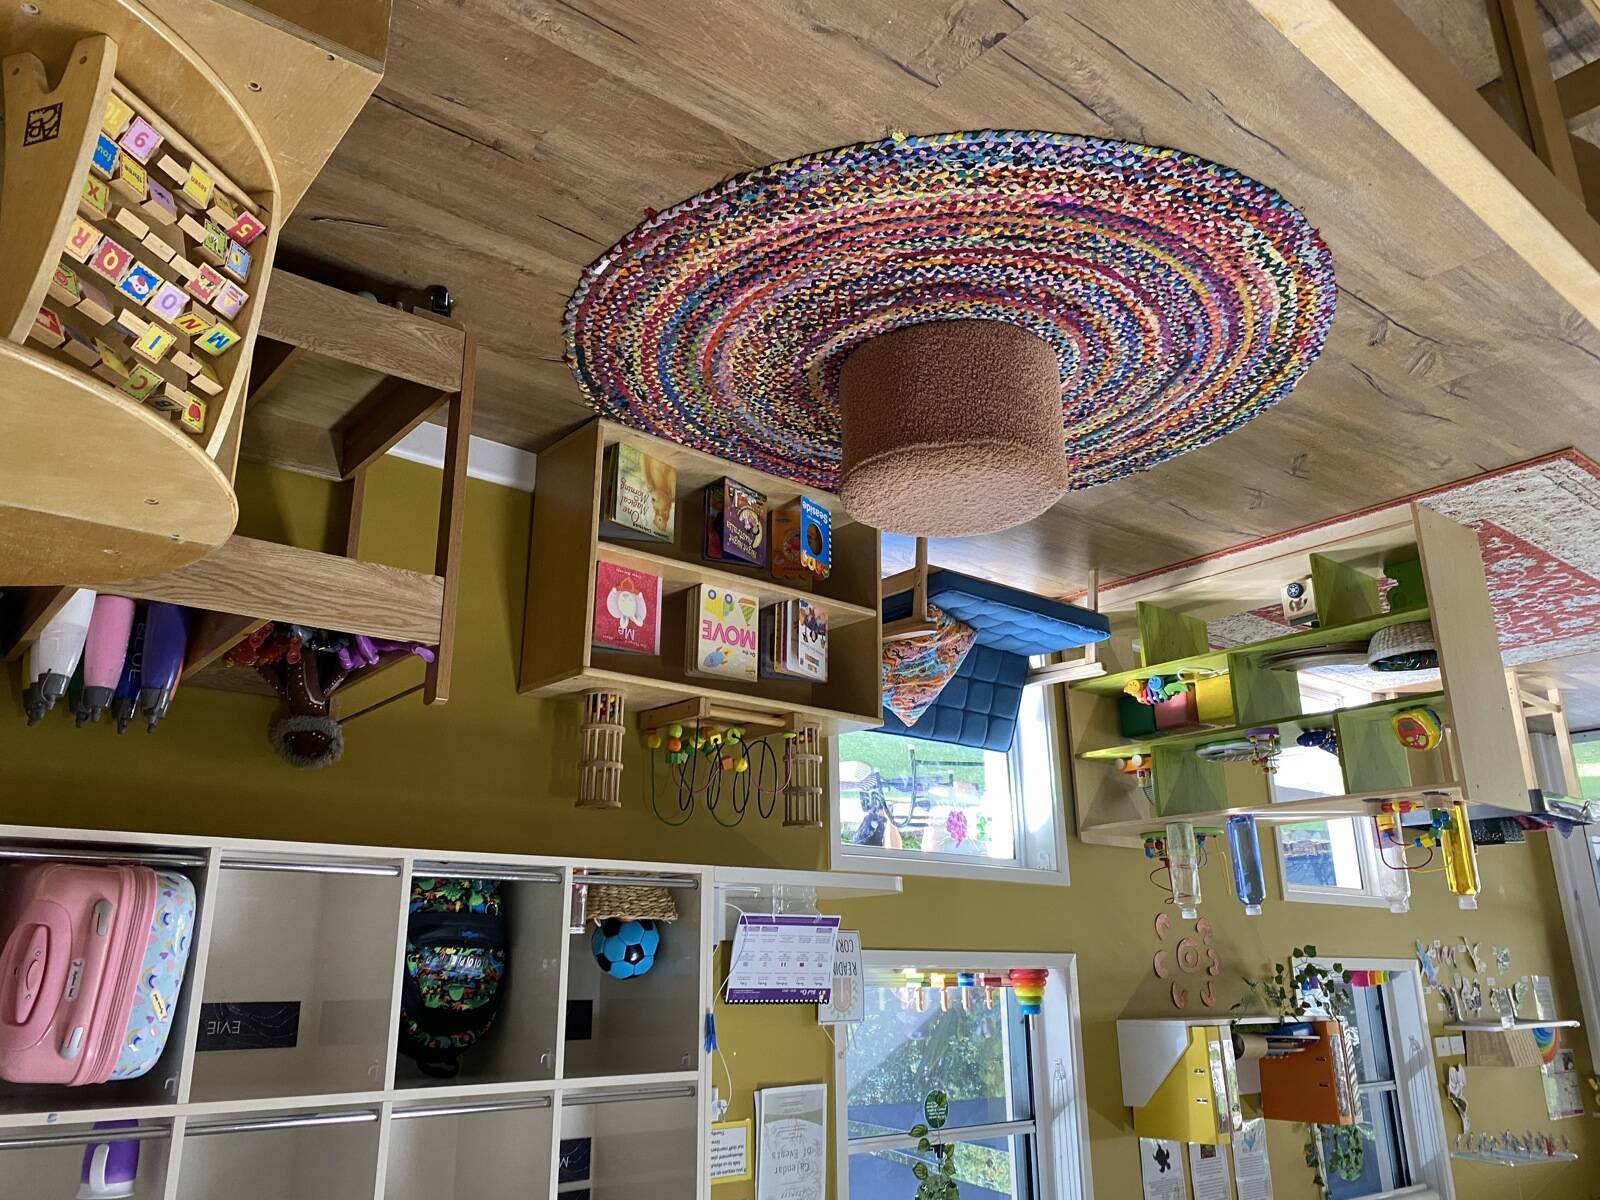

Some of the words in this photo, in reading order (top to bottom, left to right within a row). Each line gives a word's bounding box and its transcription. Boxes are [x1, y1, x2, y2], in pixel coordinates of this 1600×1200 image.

[135, 132, 149, 148] 9
[97, 145, 113, 162] fou
[124, 163, 143, 184] three
[87, 180, 98, 201] X
[190, 175, 208, 193] seven
[71, 228, 91, 249] R
[236, 223, 253, 238] 5
[102, 248, 119, 270] Q
[180, 319, 201, 330] N
[206, 332, 230, 350] M
[129, 374, 147, 391] C
[620, 477, 649, 503] Morning
[620, 495, 649, 516] Magical
[802, 501, 828, 524] Seaside
[622, 506, 639, 523] One
[617, 626, 635, 641] Me
[702, 619, 756, 651] MOVE
[206, 1020, 240, 1035] EVIE
[771, 1149, 799, 1159] Events
[803, 1147, 812, 1158] of
[774, 1161, 810, 1175] Calendar
